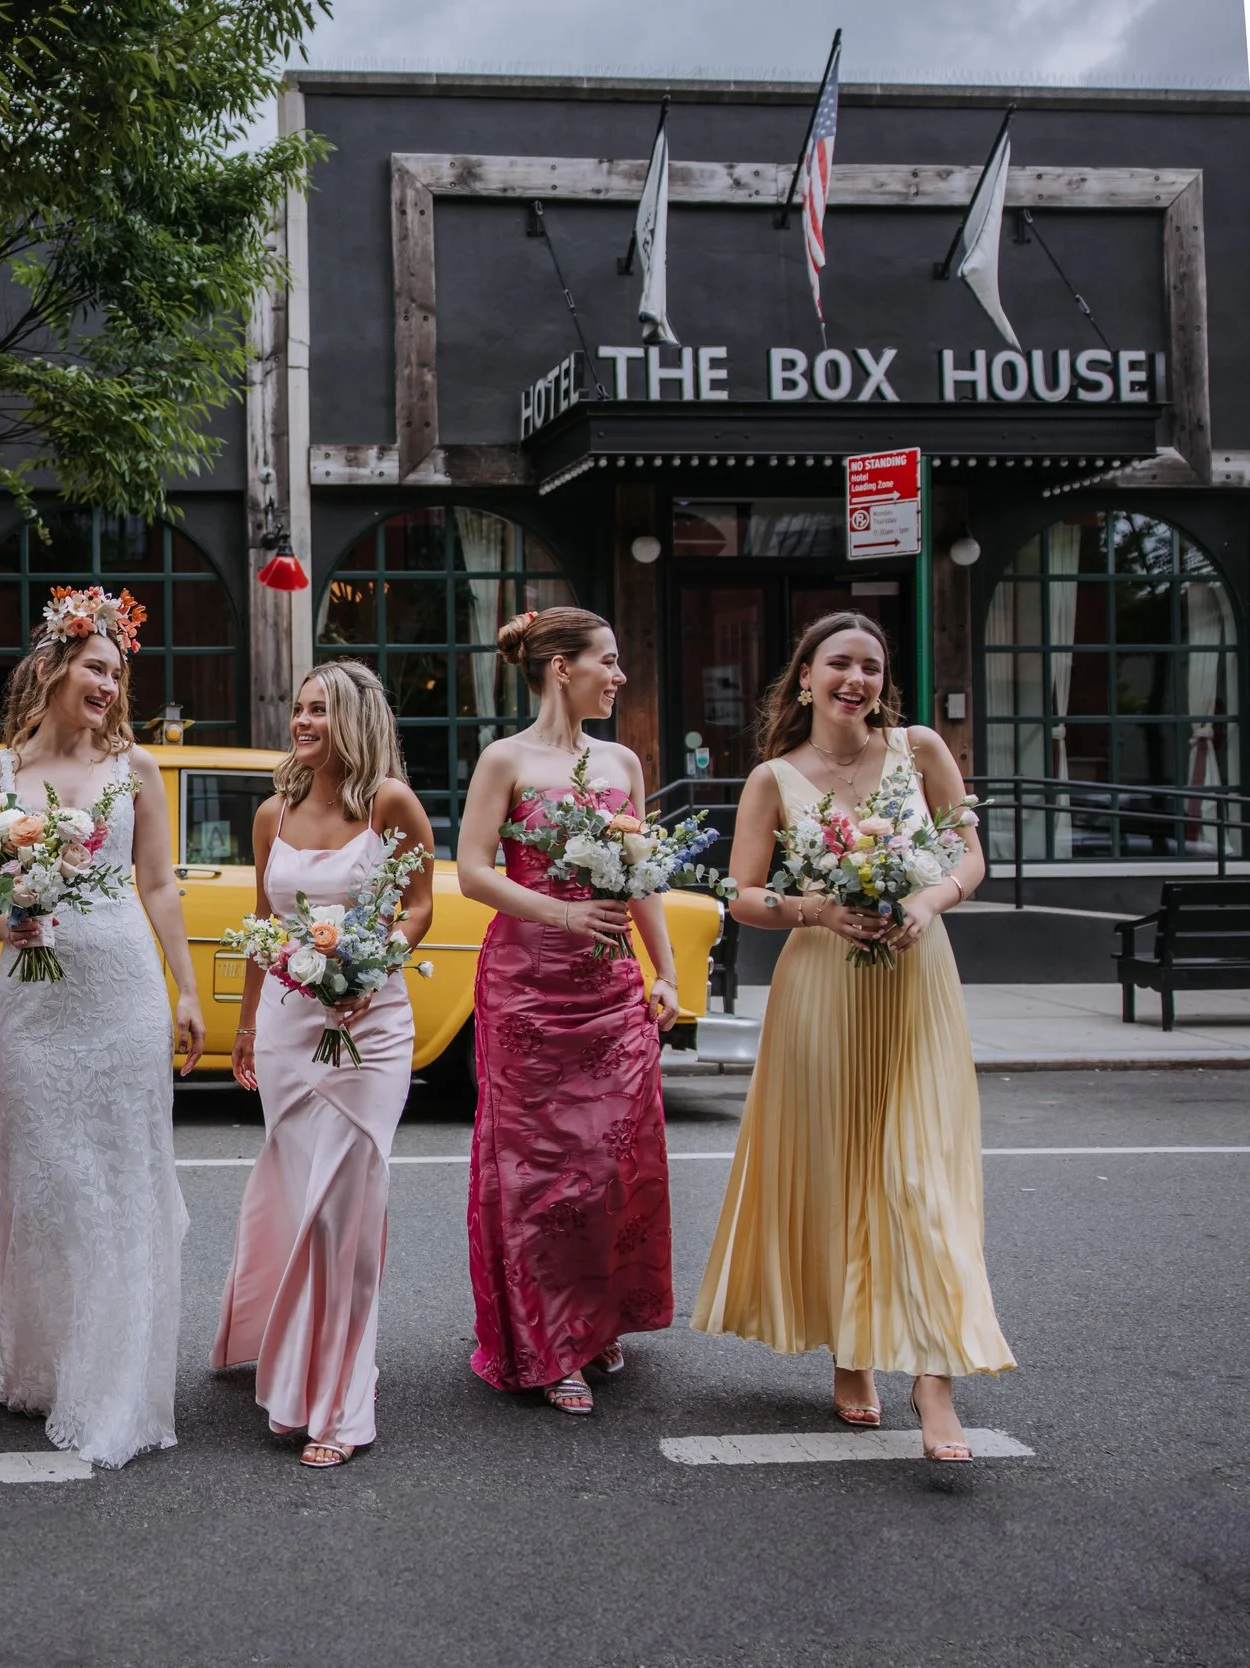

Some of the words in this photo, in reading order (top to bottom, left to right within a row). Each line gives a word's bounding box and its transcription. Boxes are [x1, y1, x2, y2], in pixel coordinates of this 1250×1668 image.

[598, 346, 729, 401] THE
[768, 347, 900, 401] BOX
[939, 349, 1149, 401] HOUSE
[521, 352, 580, 441] HOTEL
[851, 461, 863, 472] NO
[865, 455, 907, 470] STANDING
[851, 473, 869, 482] Hotel
[851, 481, 876, 492] Loading
[878, 480, 894, 489] Zone
[208, 826, 225, 848] A
